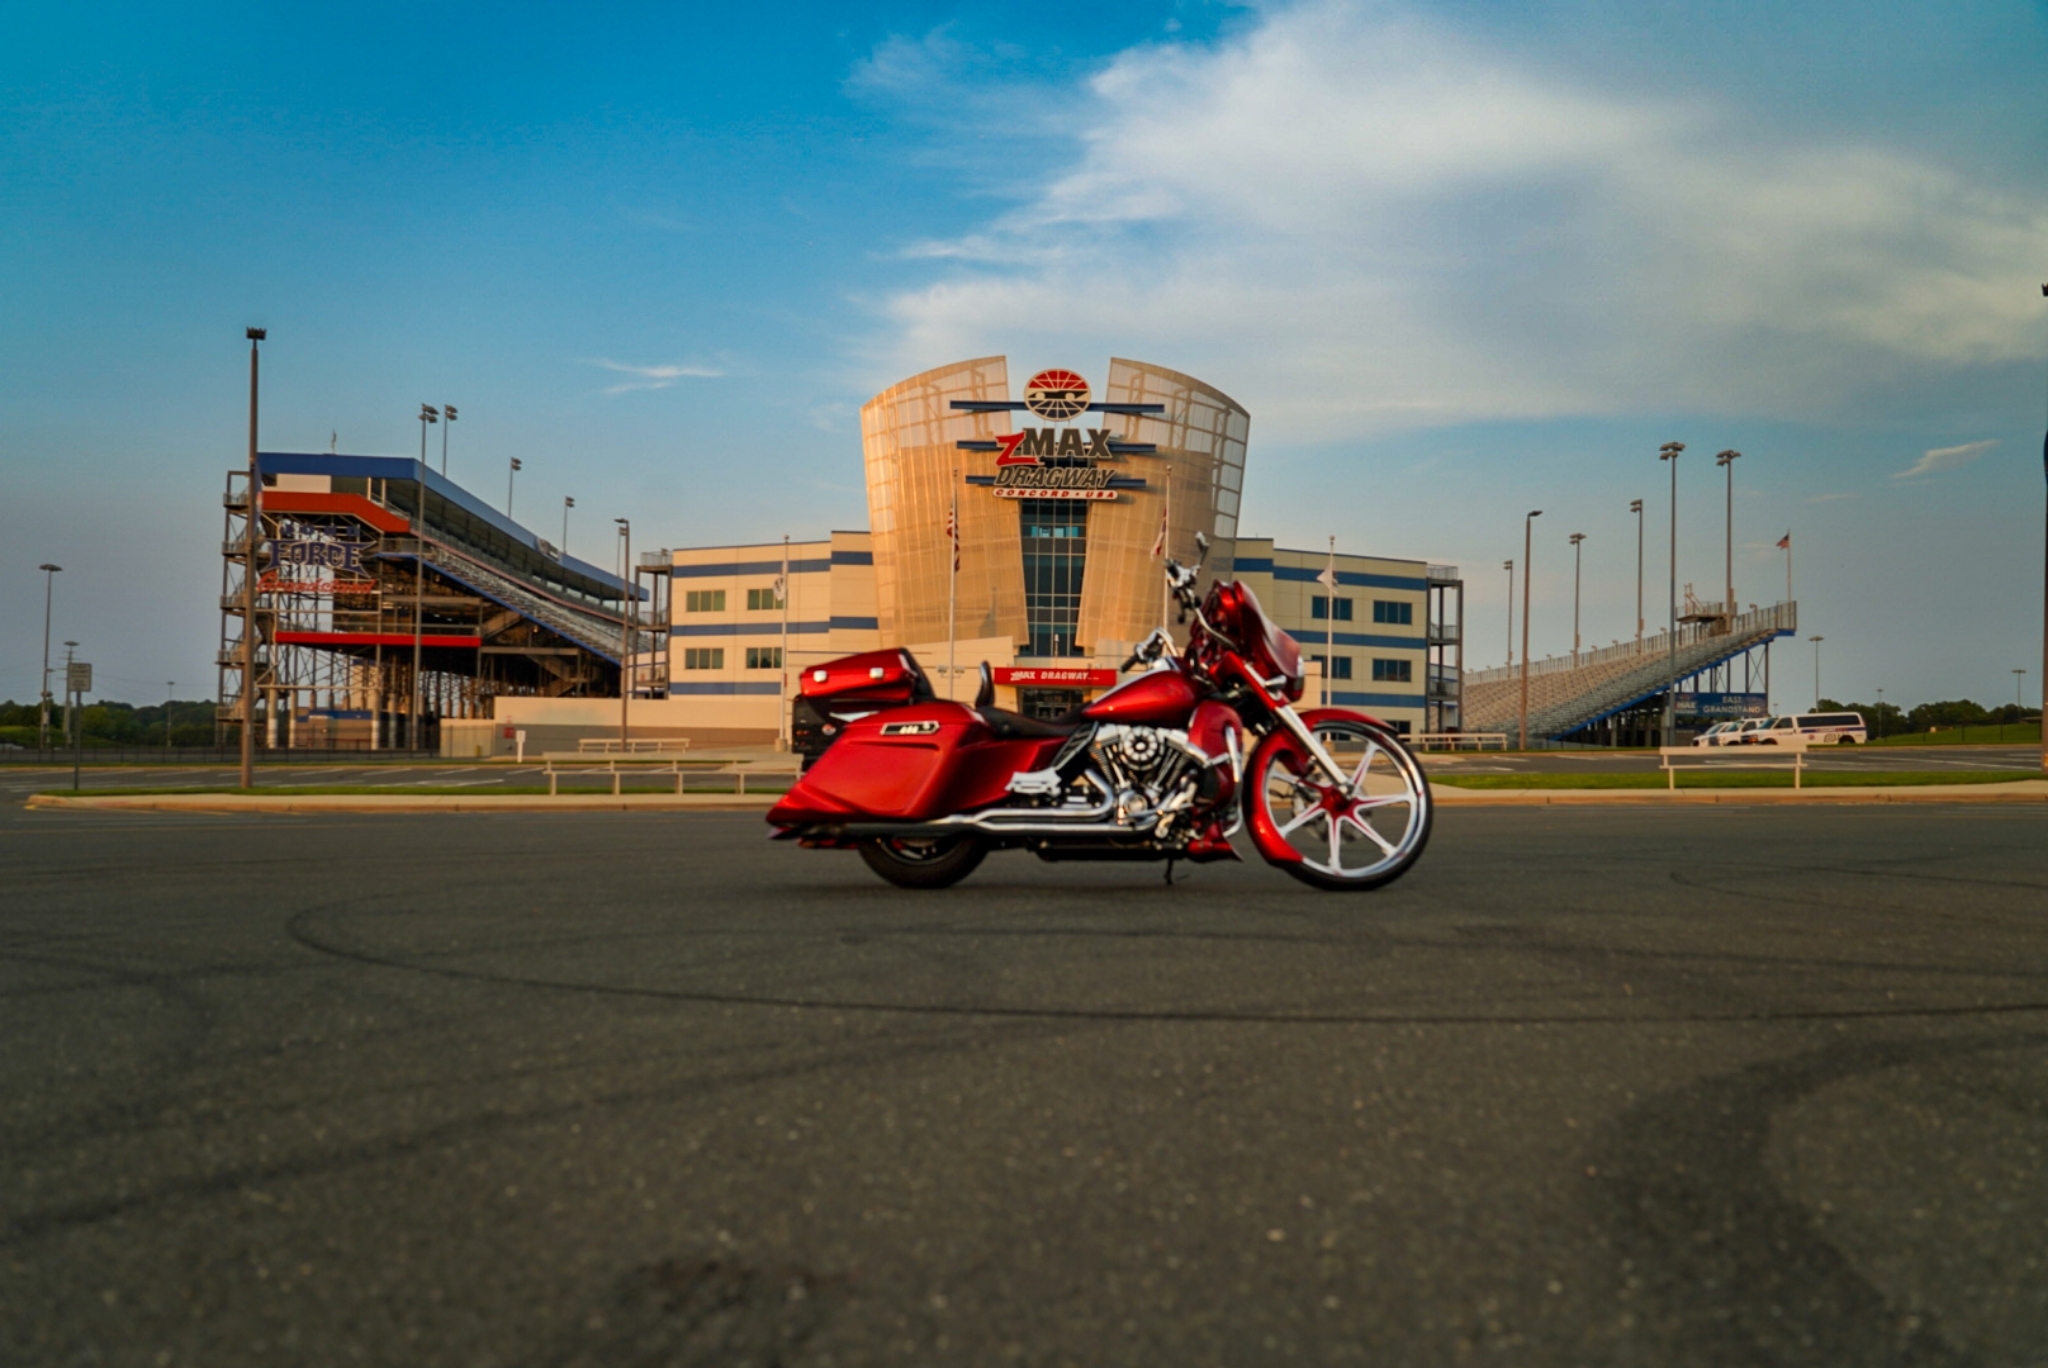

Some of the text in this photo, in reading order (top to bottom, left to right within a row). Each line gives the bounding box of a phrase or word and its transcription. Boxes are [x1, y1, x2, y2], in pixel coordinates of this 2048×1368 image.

[994, 466, 1115, 488] DRAGWAY
[995, 489, 1070, 498] CONCORD
[260, 538, 377, 578] FORCE
[1703, 705, 1761, 713] GRANDSTAND
